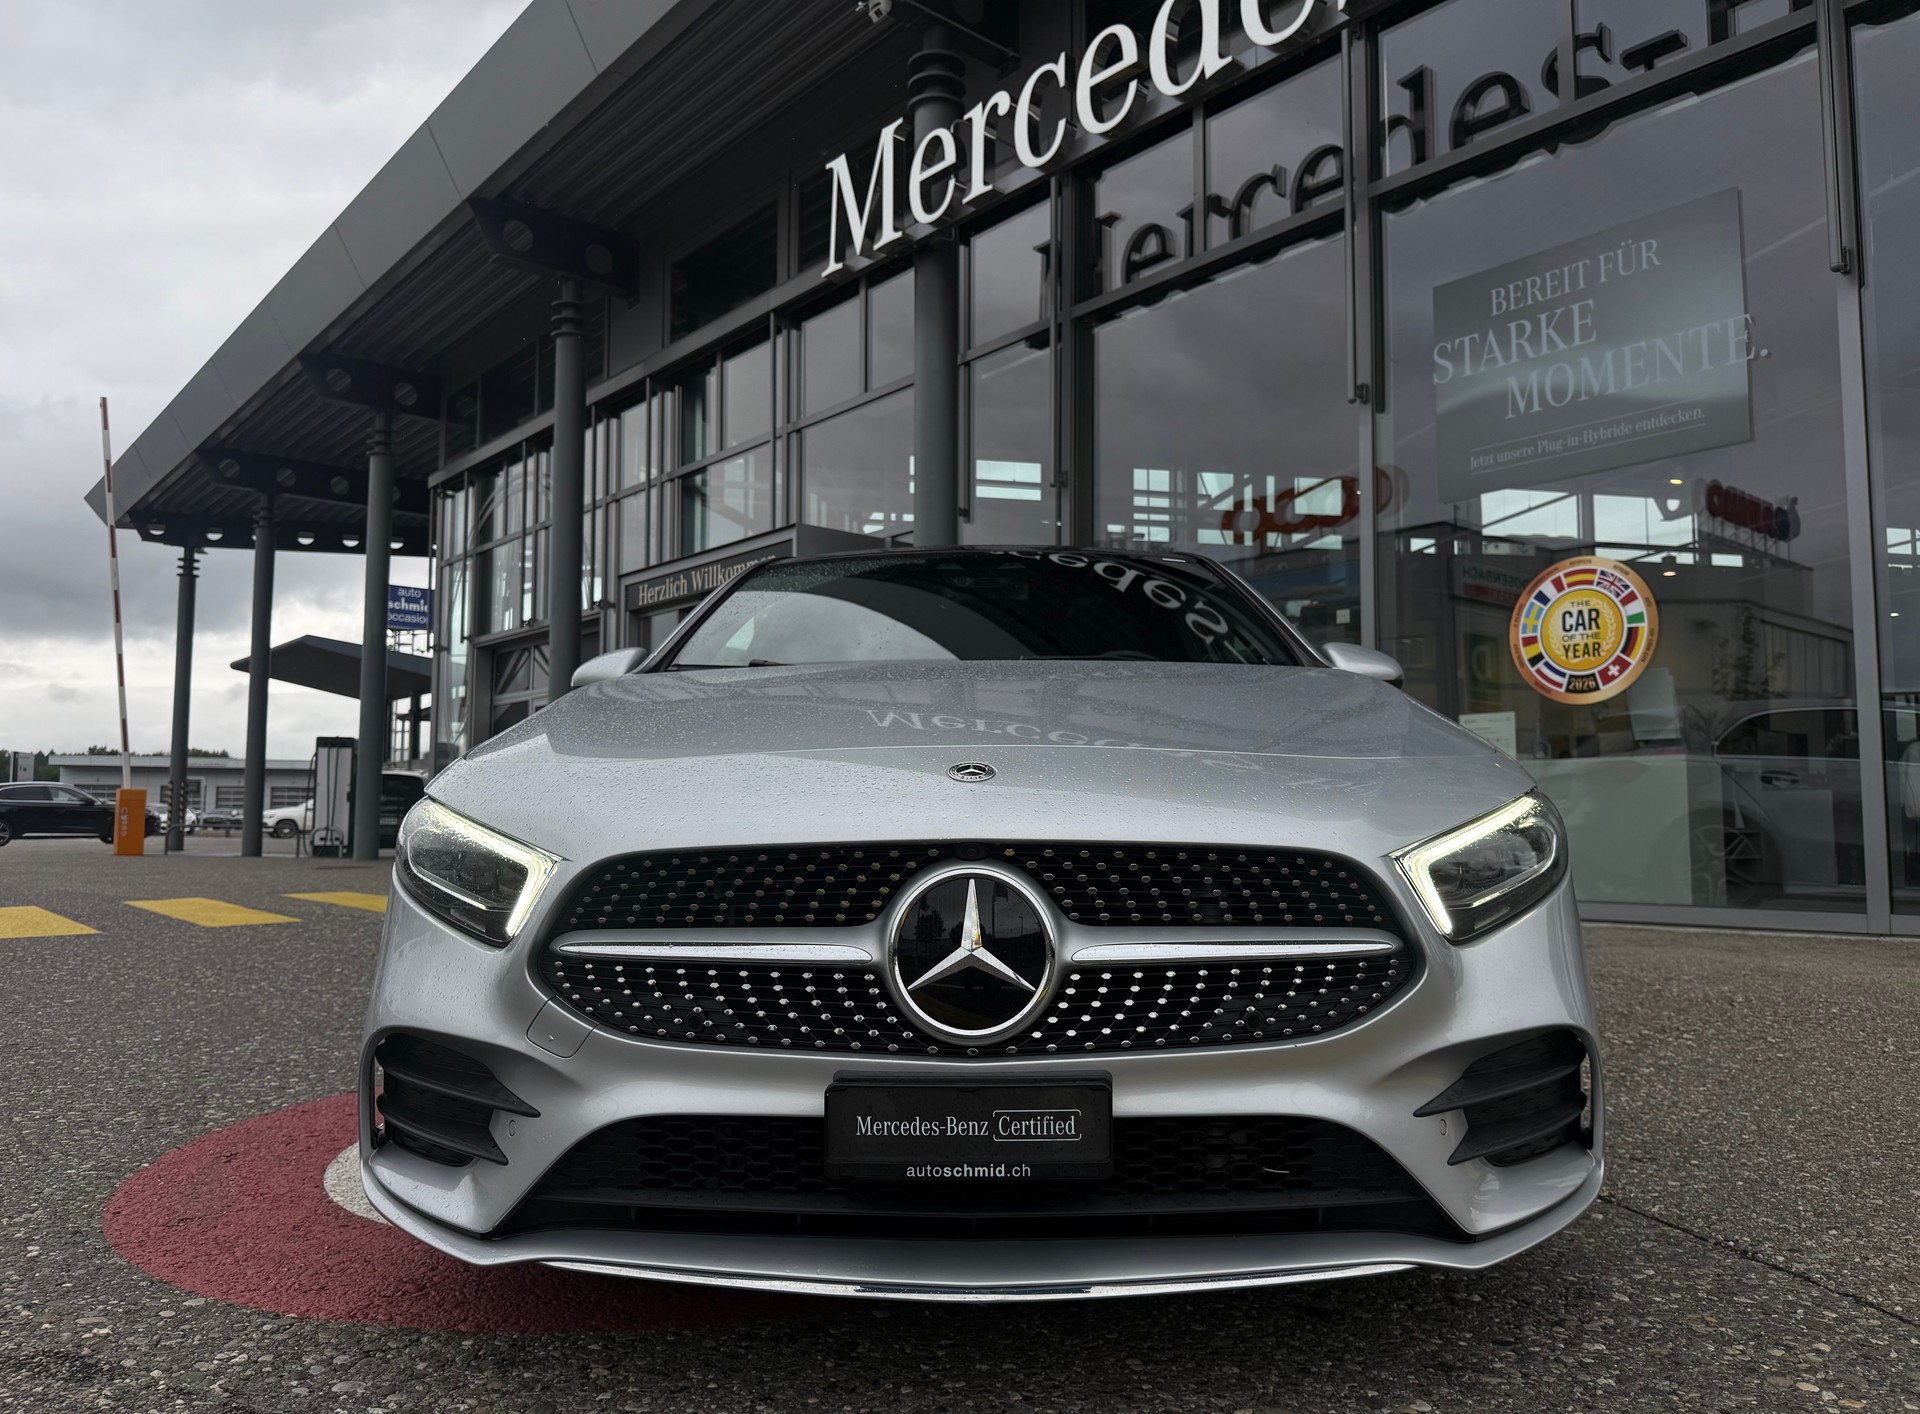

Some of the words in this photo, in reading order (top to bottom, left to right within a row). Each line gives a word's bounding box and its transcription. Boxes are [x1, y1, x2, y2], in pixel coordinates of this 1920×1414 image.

[821, 0, 1346, 278] Merced
[1489, 260, 1590, 317] BEREIT
[1598, 239, 1663, 283] FÜR
[1433, 300, 1598, 385] STARKE
[1504, 313, 1769, 420] MOMENTE.
[1470, 455, 1495, 471] Jetzt
[1497, 448, 1534, 464] unsere
[1537, 422, 1632, 454] Plug-in-Hybride
[1635, 407, 1706, 433] entdecken.
[638, 575, 688, 606] Herzlich
[691, 555, 776, 591] Willkom
[397, 587, 422, 598] auto
[388, 612, 428, 624] occasio
[1561, 608, 1601, 632] CAR
[1561, 634, 1577, 642] OF
[1562, 642, 1602, 659] YEAR
[1568, 677, 1596, 691] 2026
[855, 1115, 989, 1136] Mercedes-Benz
[998, 1115, 1076, 1136] Certified
[906, 1164, 1031, 1178] autoschmid.ch
